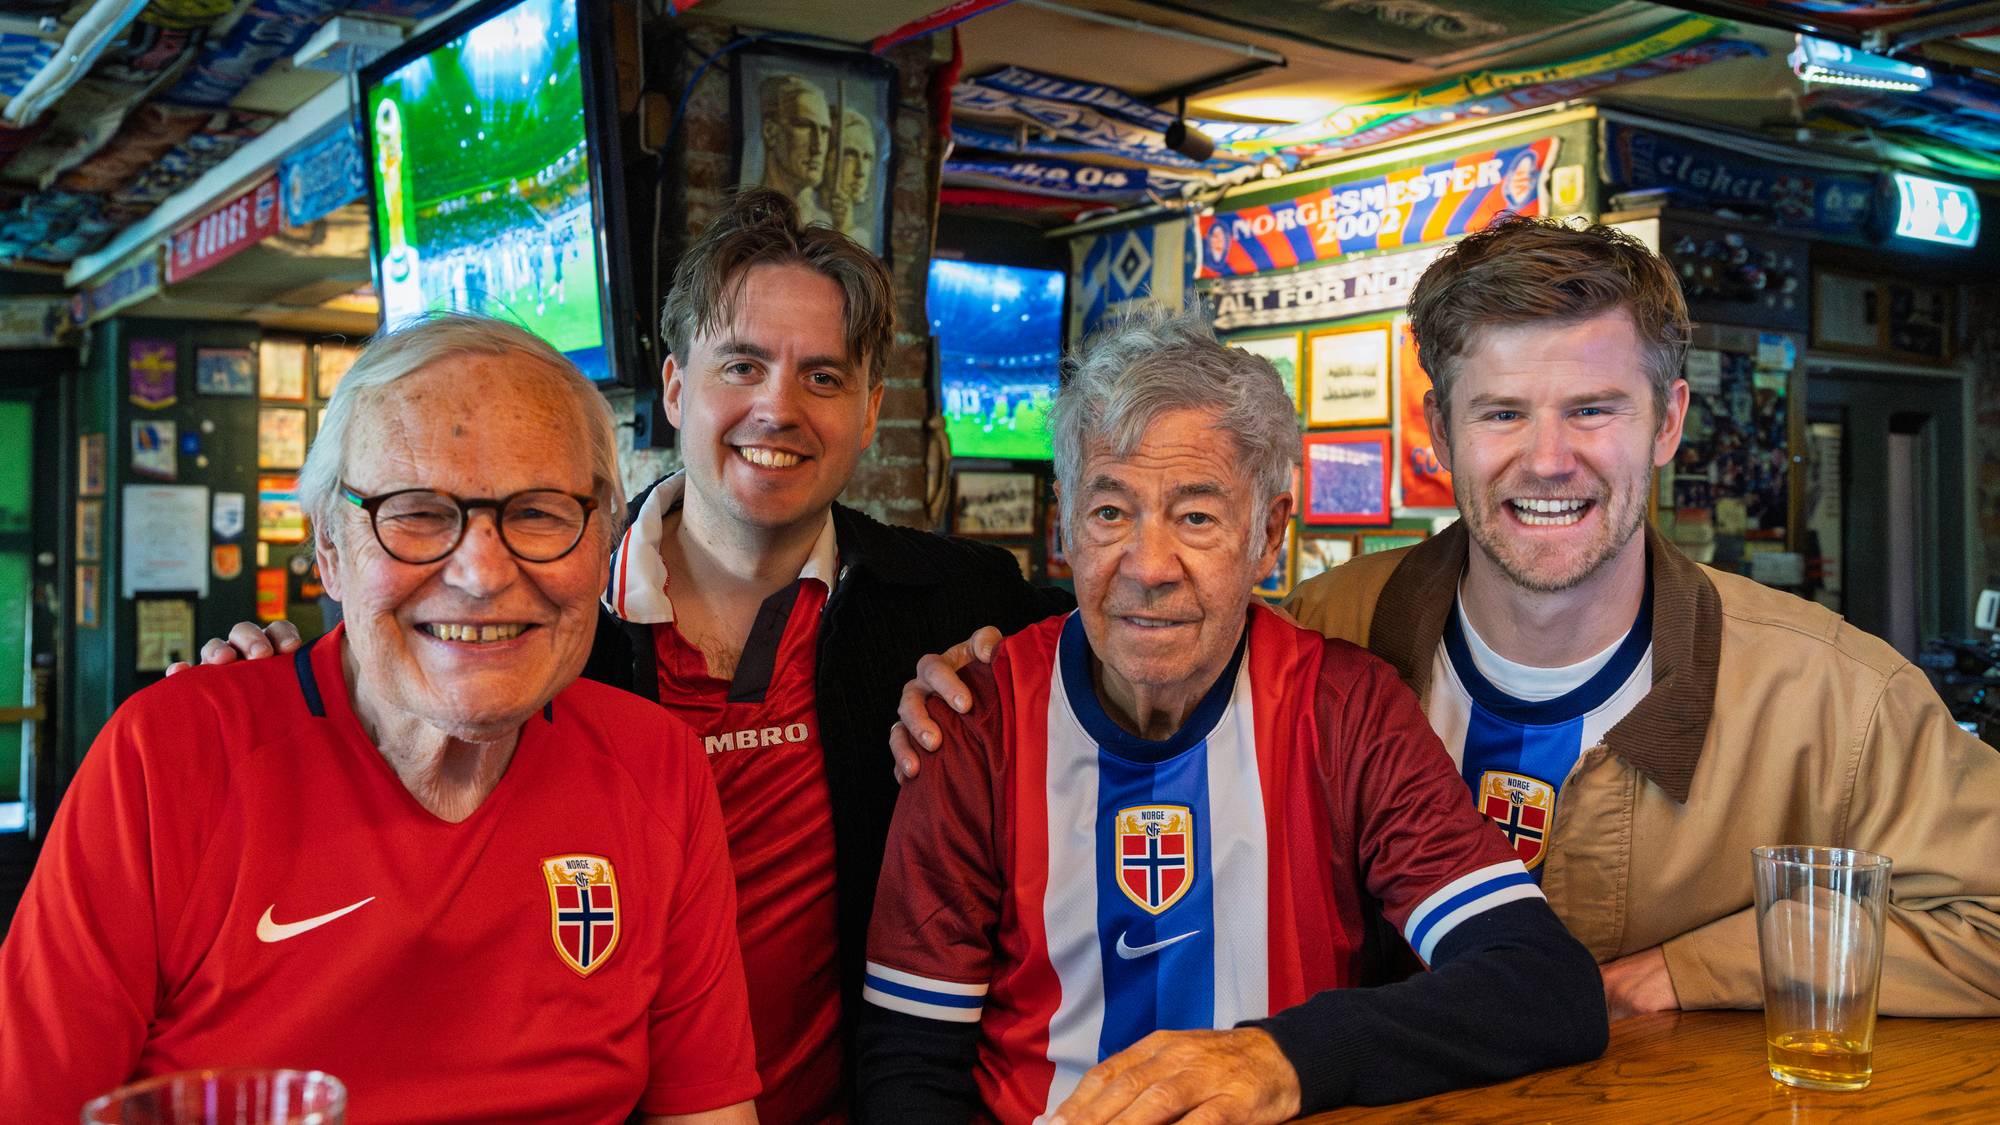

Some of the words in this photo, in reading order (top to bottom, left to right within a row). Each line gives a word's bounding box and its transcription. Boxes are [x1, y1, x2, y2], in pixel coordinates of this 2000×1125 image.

[1231, 158, 1503, 241] NORGESMESTER
[1316, 206, 1402, 245] 2002
[1217, 289, 1269, 316] ALT
[1277, 281, 1346, 308] FOR
[699, 722, 809, 755] MBRO
[1507, 777, 1531, 791] NORGE
[1141, 810, 1165, 821] NORGE
[565, 859, 591, 870] NORGE
